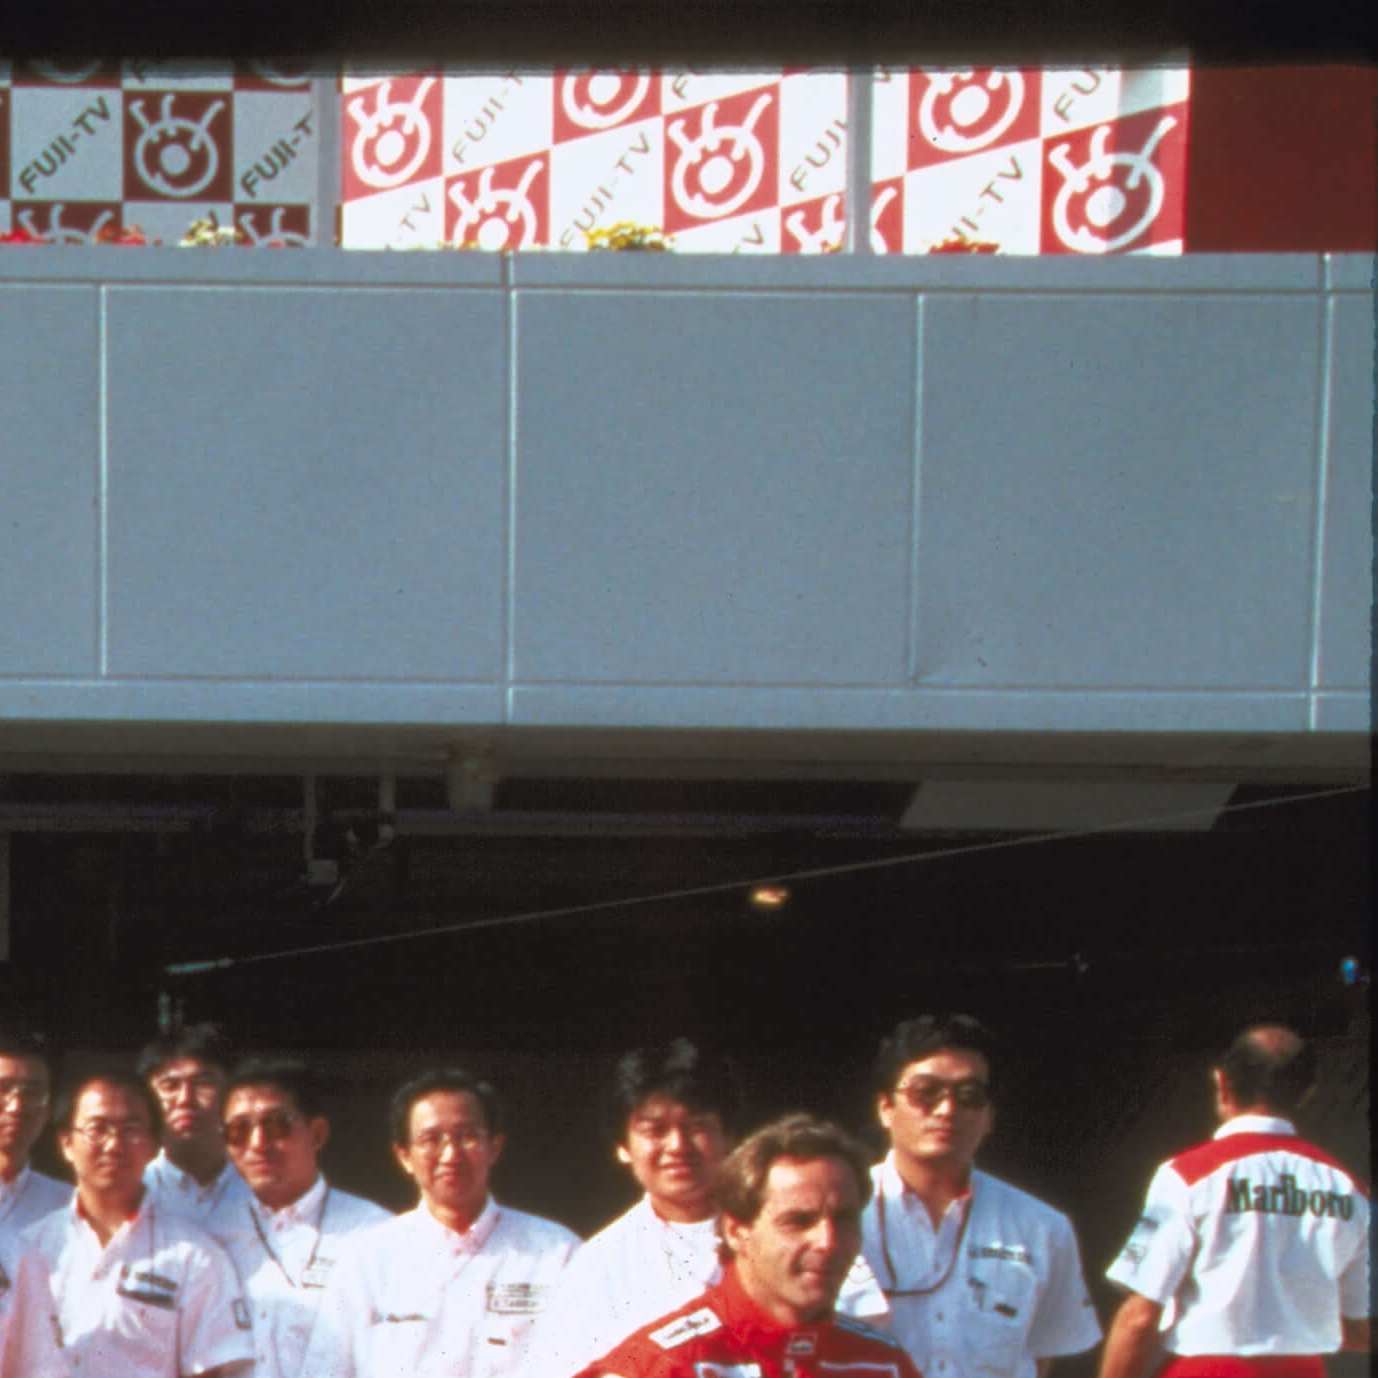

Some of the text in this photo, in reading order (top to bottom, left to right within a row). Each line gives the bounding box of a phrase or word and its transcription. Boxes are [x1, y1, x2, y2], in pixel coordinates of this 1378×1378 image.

[19, 95, 111, 194] FUJI-TV
[240, 111, 314, 198] FUJI-T
[452, 70, 524, 163] FUJI-T
[1225, 1173, 1356, 1221] Marlboro
